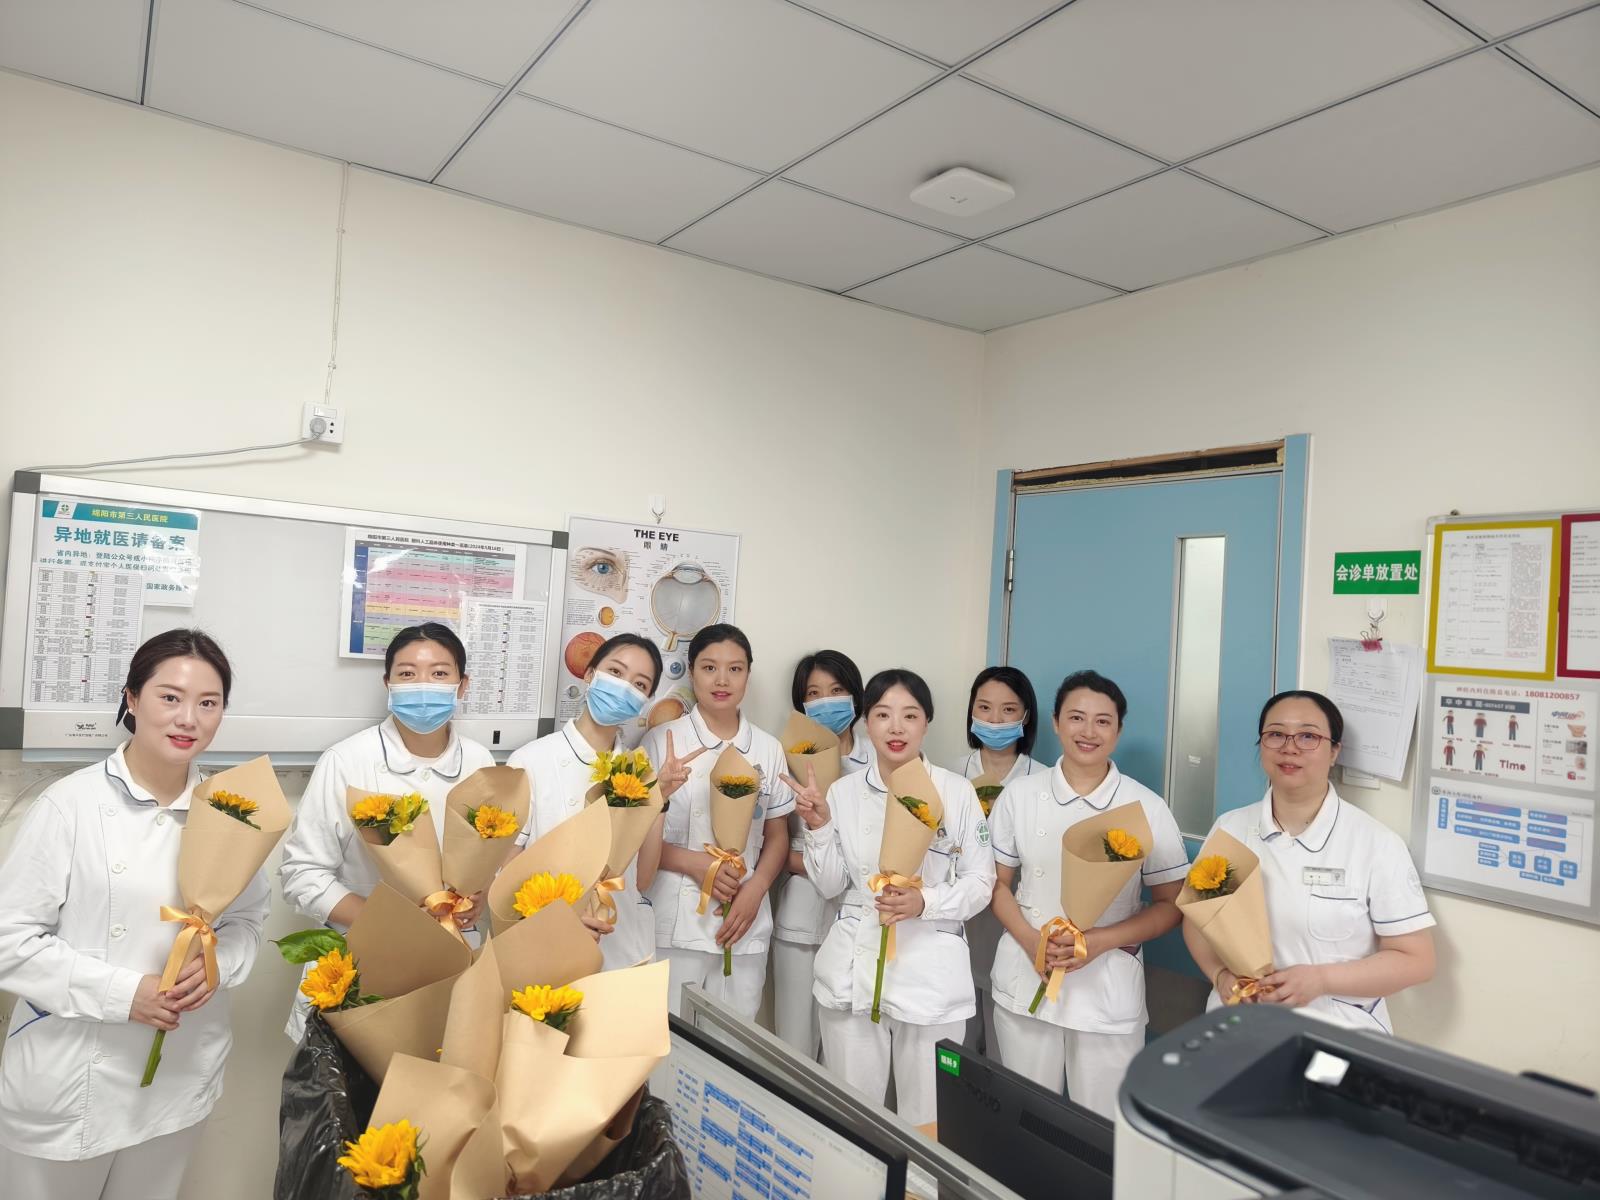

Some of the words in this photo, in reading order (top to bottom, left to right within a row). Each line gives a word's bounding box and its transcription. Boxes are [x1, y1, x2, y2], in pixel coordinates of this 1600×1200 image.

[91, 510, 168, 522] 绵阳市第三人民医院
[54, 526, 185, 551] 异地就医请备案
[634, 529, 656, 539] THE
[658, 531, 680, 542] EYE
[1336, 563, 1418, 582] 会诊单放置处
[1499, 759, 1527, 772] Time
